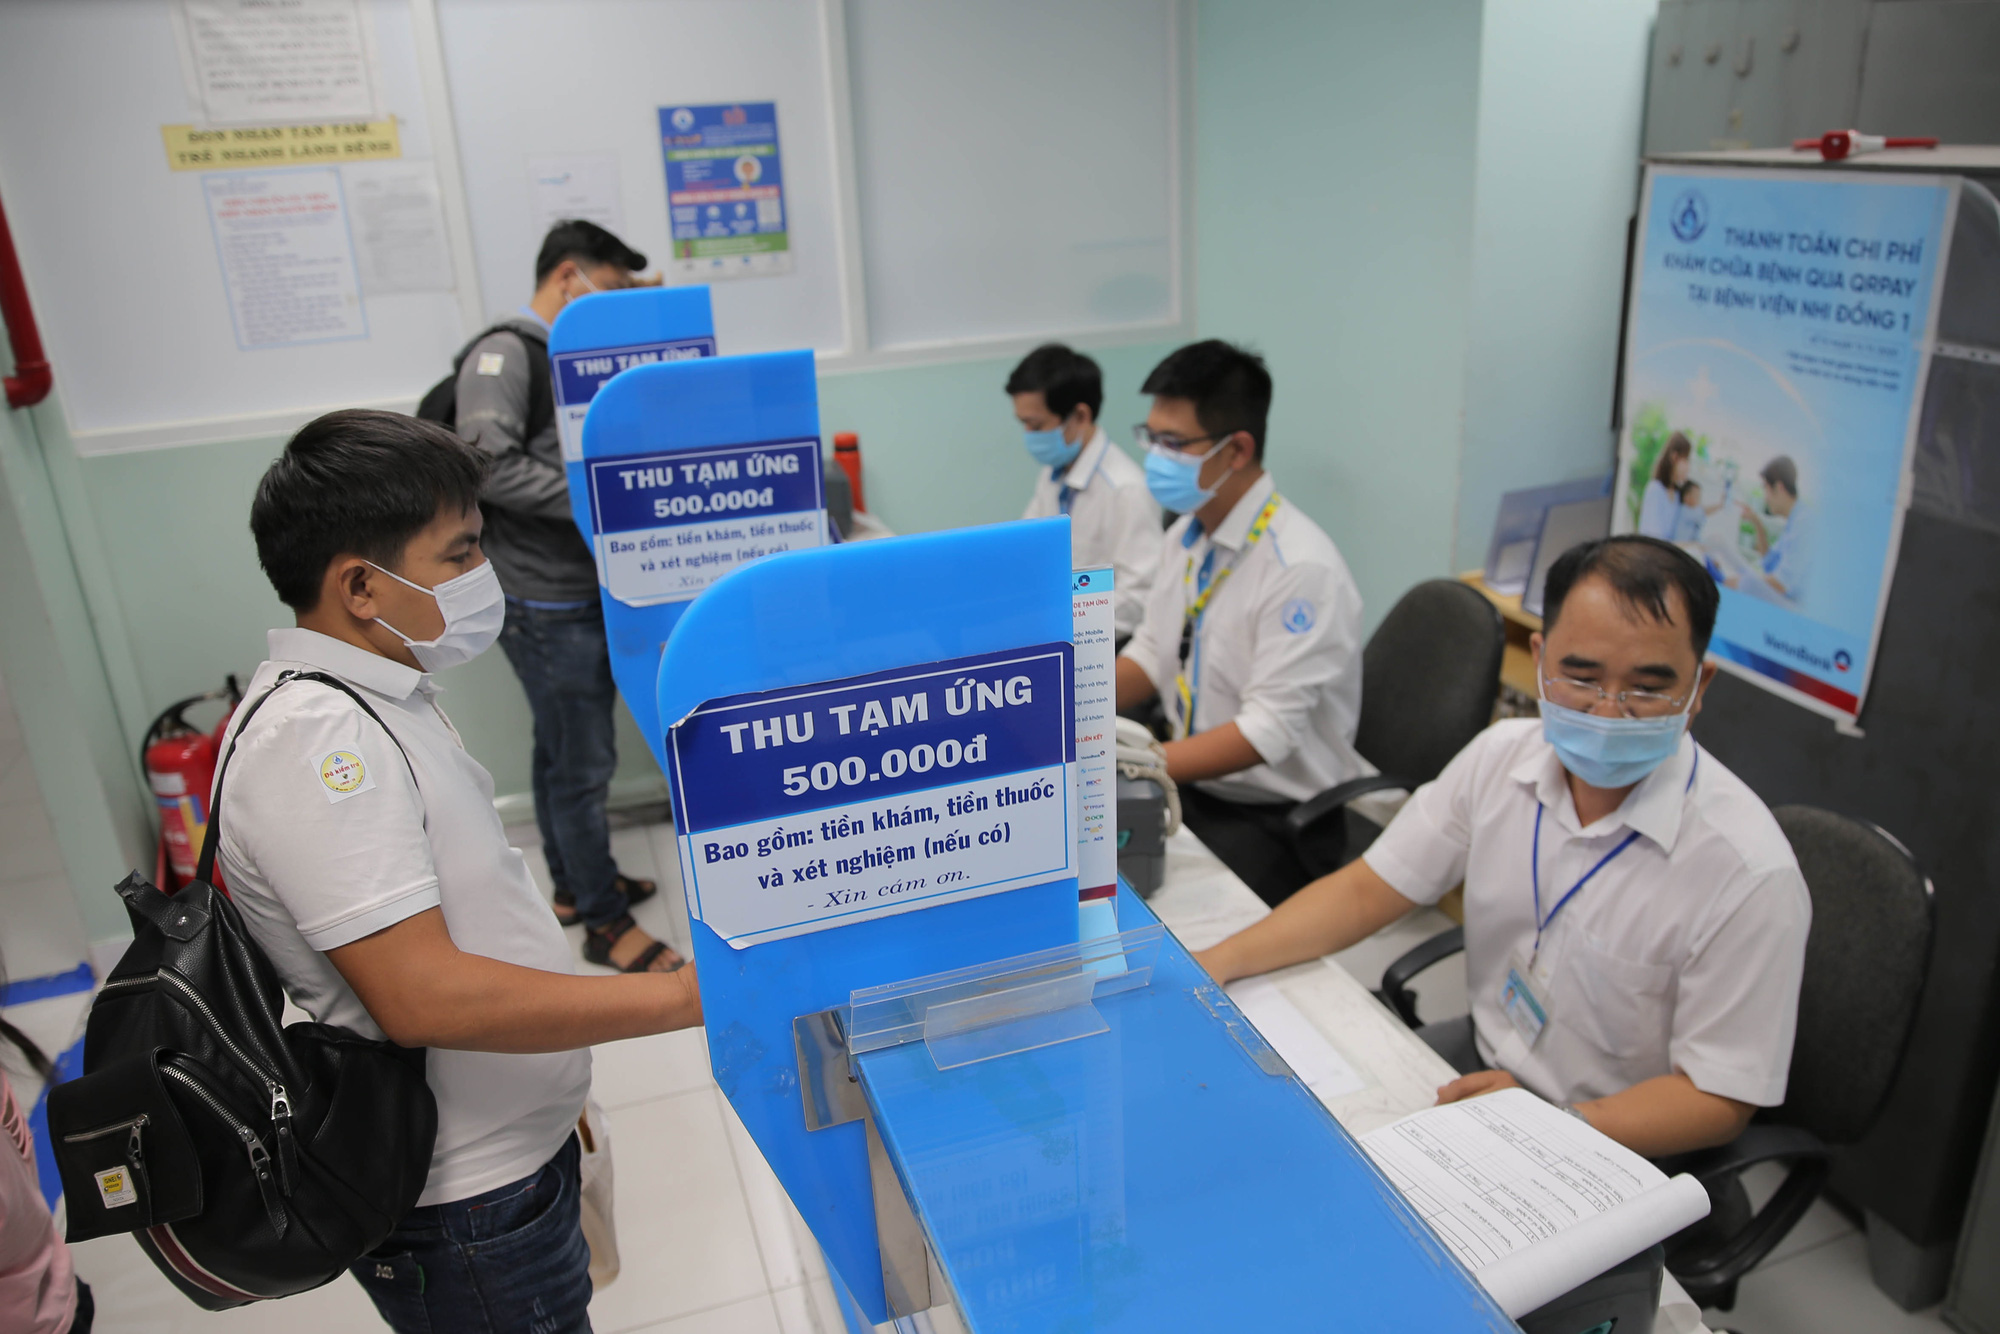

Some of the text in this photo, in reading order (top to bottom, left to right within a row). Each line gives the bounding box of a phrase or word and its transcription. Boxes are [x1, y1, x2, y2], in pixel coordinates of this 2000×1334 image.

[1724, 227, 1924, 264] THANH TOÁN CHI PHÍ
[1663, 251, 1917, 298] KHÁM CHỮA BỆNH QUA QRPAY
[1714, 287, 1756, 312] BỆNH
[1759, 293, 1799, 317] VIỆN
[1801, 300, 1832, 321] NHI
[1835, 301, 1896, 330] ĐỒNG
[1902, 313, 1911, 332] 1
[573, 357, 614, 377] THU
[619, 453, 800, 490] THU TẠM ỨNG
[654, 487, 774, 518] 500.000đ
[610, 516, 815, 554] Bao gồm: tiền khám, tiền thuốc
[640, 558, 656, 572] và
[660, 555, 681, 570] xét
[685, 549, 733, 568] nghiệm
[737, 544, 765, 562] (nếu
[677, 575, 704, 588] Xin
[1082, 600, 1095, 609] TẠM
[1096, 598, 1109, 607] ỨNG
[1085, 628, 1104, 636] Mobile
[1095, 636, 1110, 644] chọn
[1096, 662, 1104, 670] thị
[720, 675, 1032, 755] THU TẠM ỨNG
[782, 733, 988, 797] 500.000đ
[704, 778, 1055, 864] Bao gồm: tiền khám, tiền thuốc
[758, 822, 1012, 890] và xét nghiệm (nếu có)
[823, 889, 868, 909] Xin
[878, 876, 928, 898] cám
[936, 868, 971, 887] ơn.
